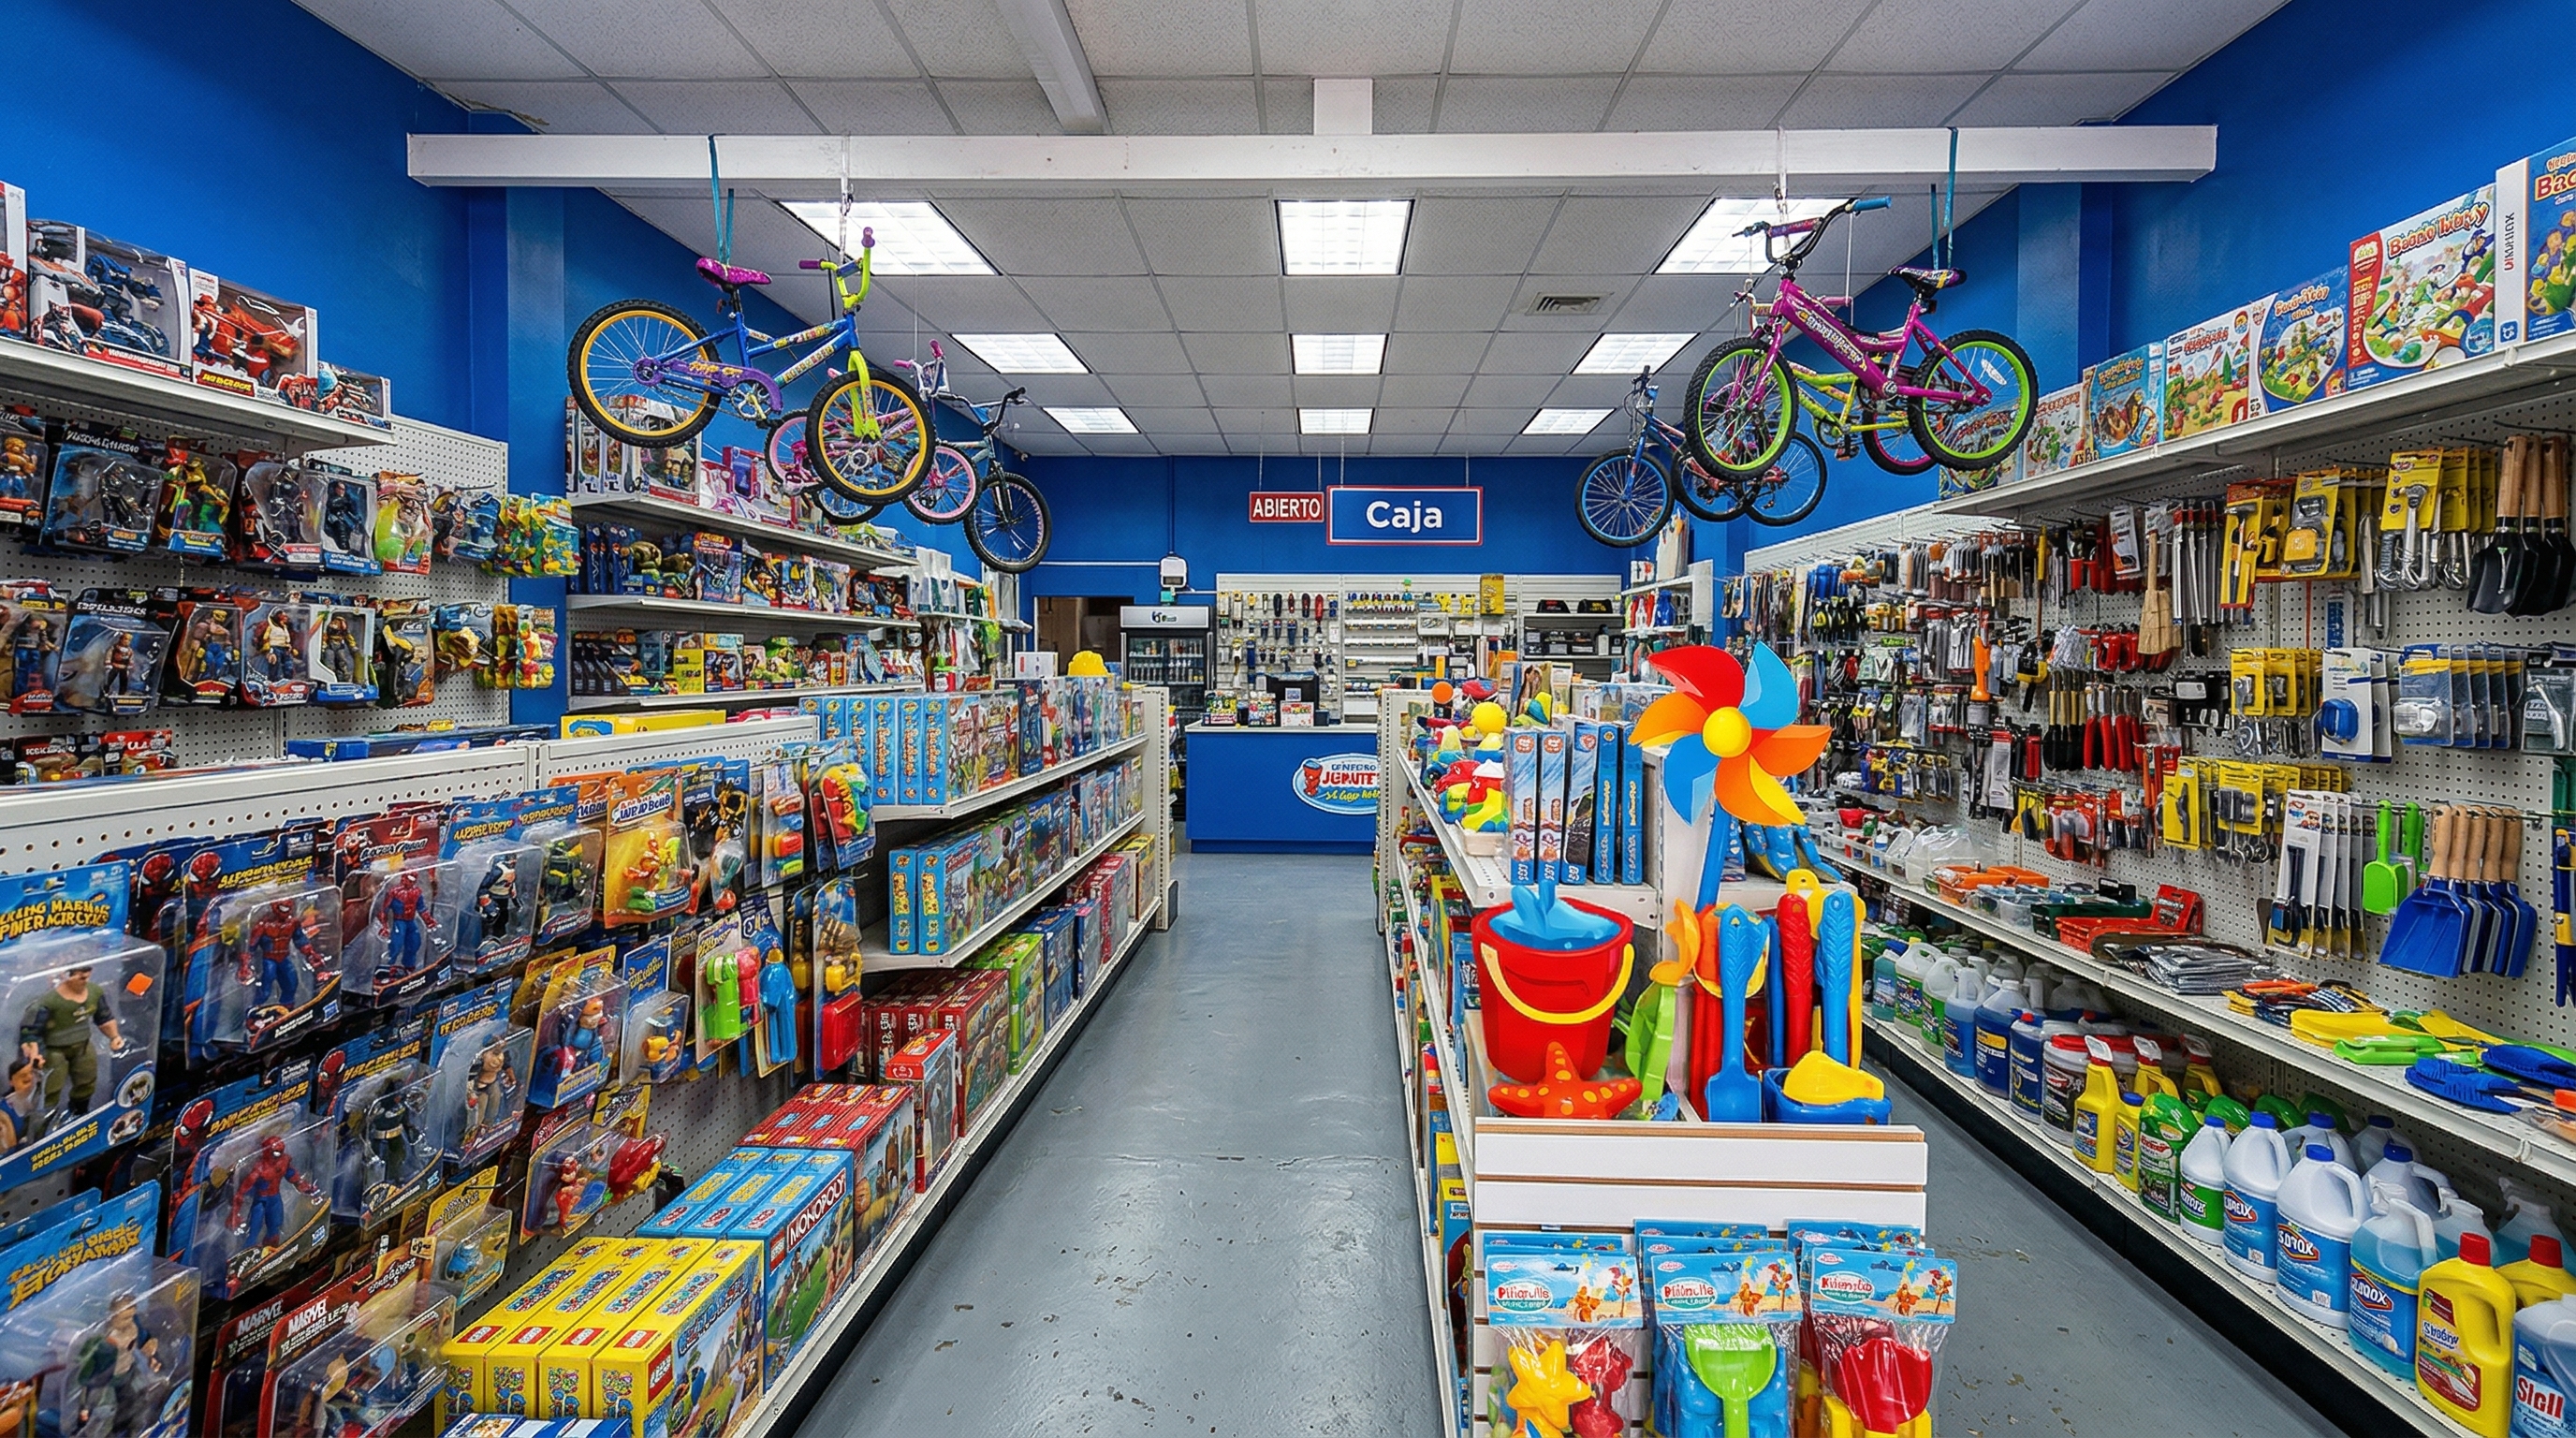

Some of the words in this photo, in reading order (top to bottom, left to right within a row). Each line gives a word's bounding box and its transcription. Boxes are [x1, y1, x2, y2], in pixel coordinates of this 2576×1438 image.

[1252, 497, 1321, 519] ABIERTO
[1366, 500, 1442, 534] Caja
[789, 1173, 846, 1246] MONOPOLY
